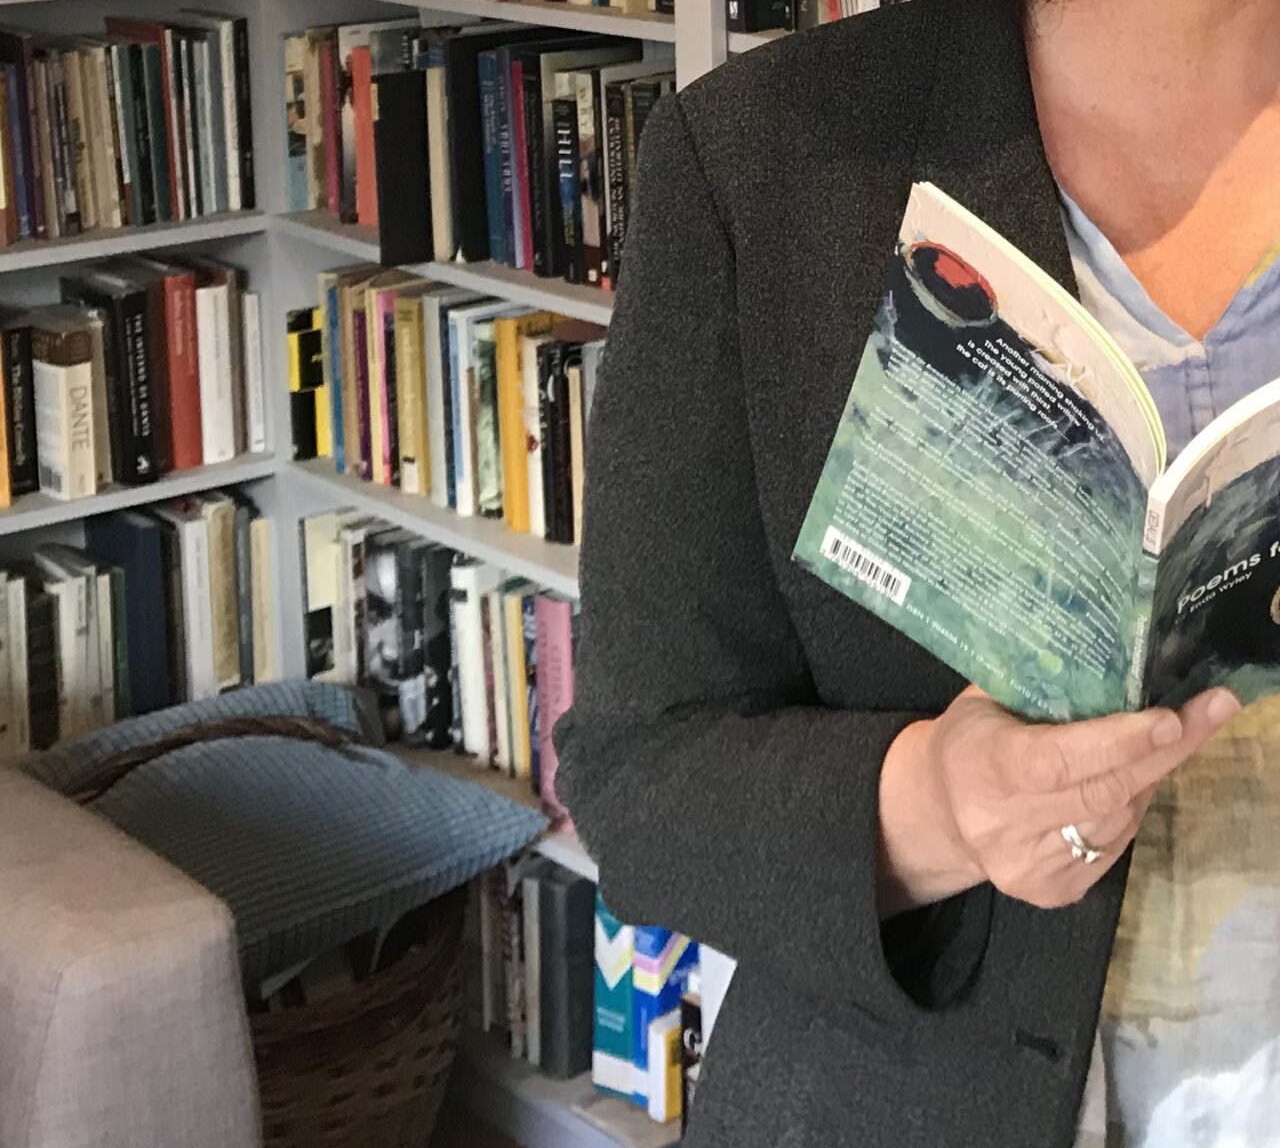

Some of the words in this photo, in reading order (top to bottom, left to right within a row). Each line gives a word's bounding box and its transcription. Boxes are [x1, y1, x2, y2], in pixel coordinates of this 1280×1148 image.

[984, 339, 1000, 355] The
[1000, 353, 1027, 380] young
[1027, 374, 1057, 403] potted
[1056, 402, 1082, 428] willow
[69, 385, 90, 452] DANTE
[1176, 551, 1262, 615] poems
